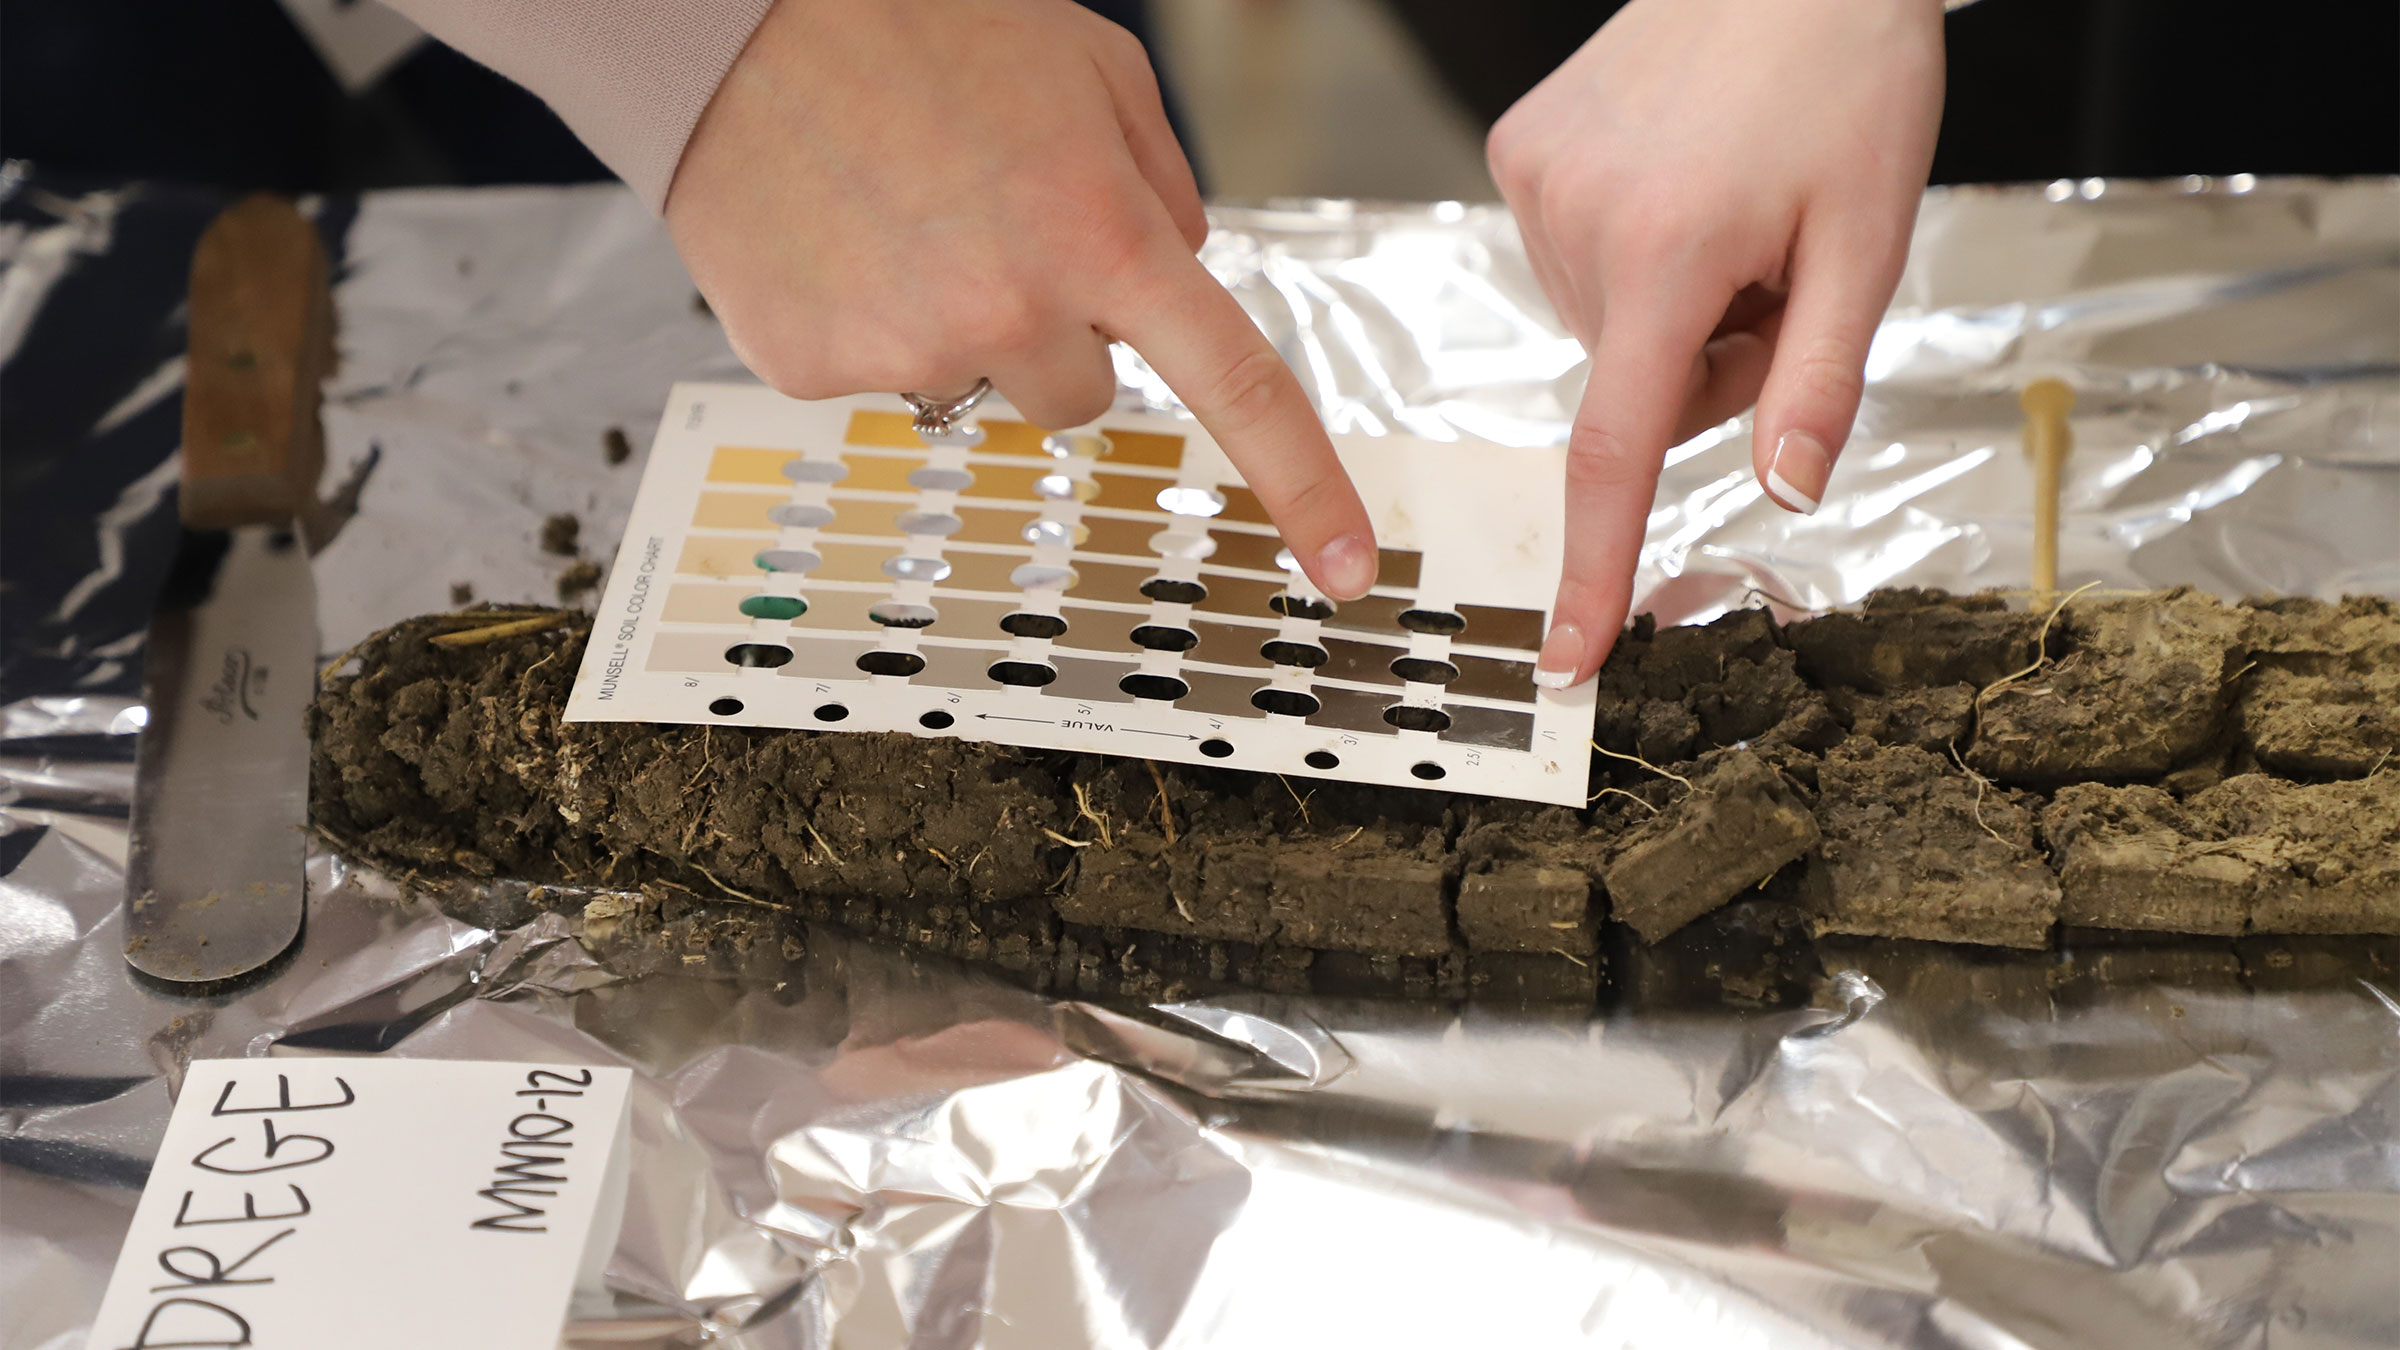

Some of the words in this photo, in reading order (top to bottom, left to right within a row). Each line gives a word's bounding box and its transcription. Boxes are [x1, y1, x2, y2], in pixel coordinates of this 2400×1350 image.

[640, 536, 664, 574] CHART
[627, 575, 652, 614] COLOR
[618, 616, 640, 641] SOIL
[1060, 719, 1114, 732] VALUE
